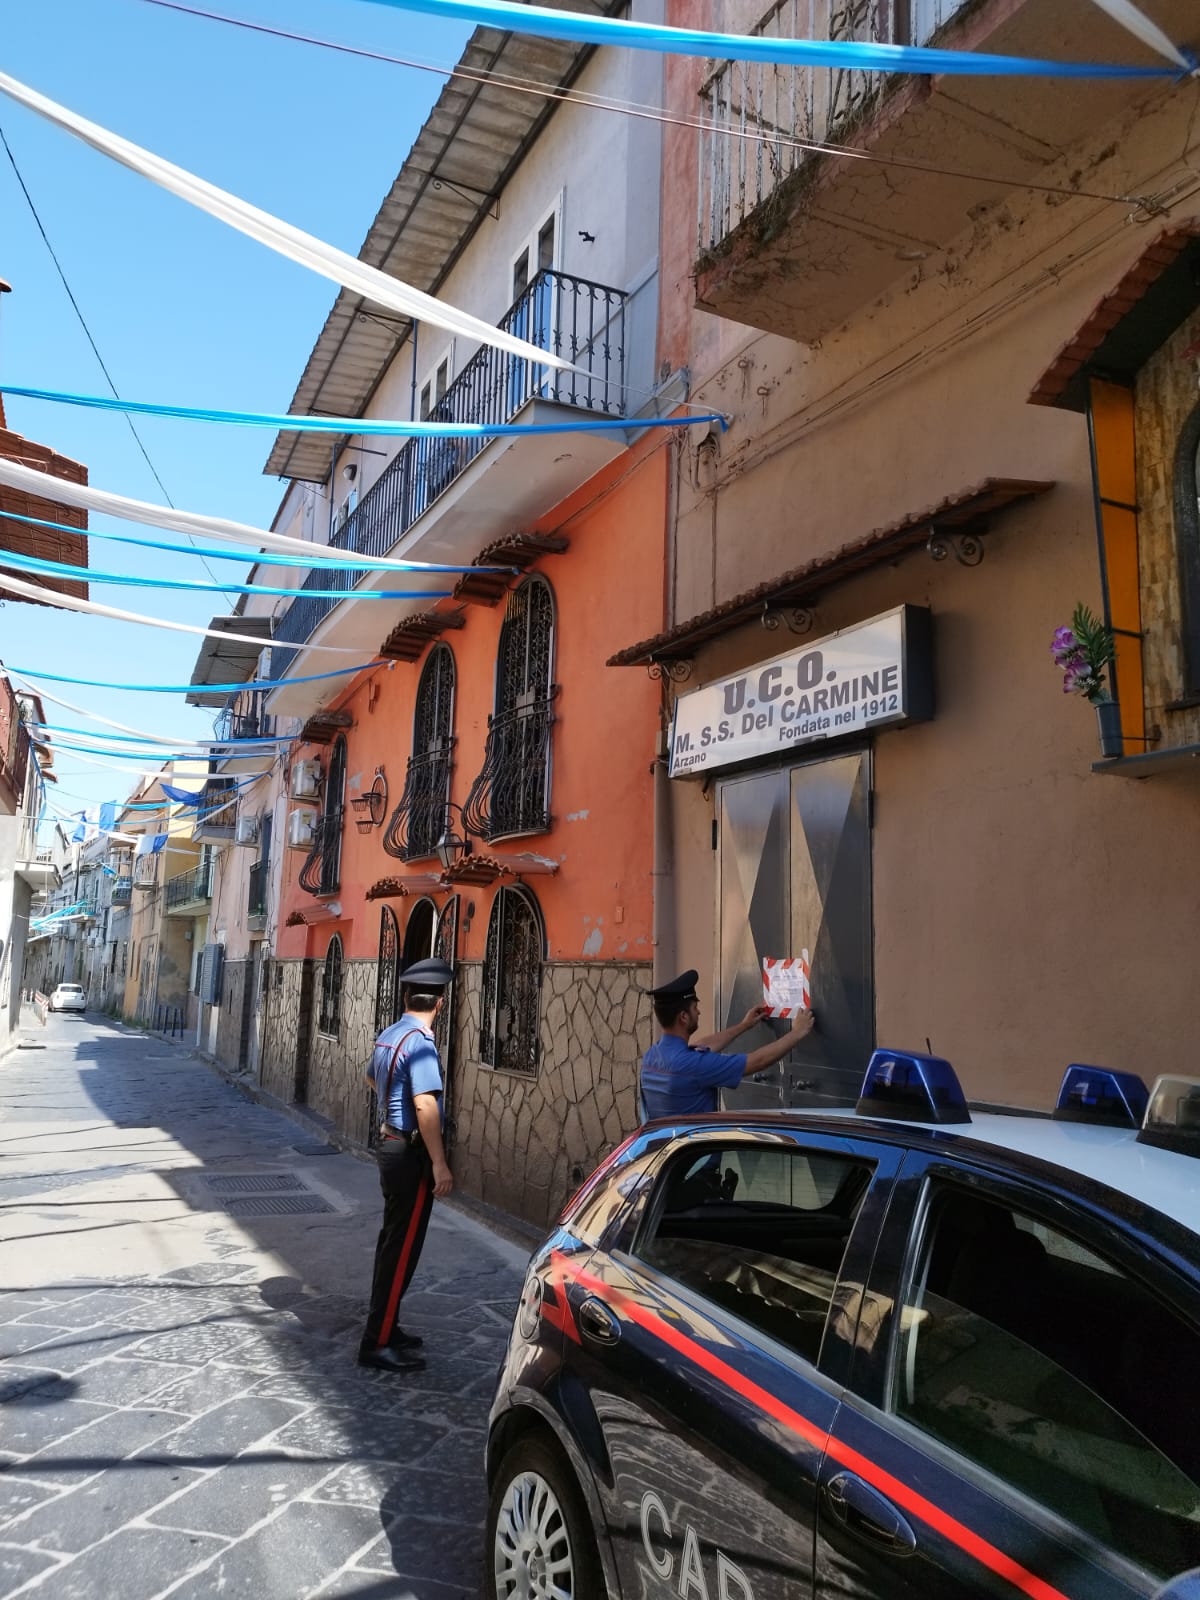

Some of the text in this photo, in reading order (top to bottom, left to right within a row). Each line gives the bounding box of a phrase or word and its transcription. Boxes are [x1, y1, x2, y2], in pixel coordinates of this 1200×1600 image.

[675, 665, 898, 755] M. S.S. Del CARMINE
[723, 650, 837, 716] U.C.O.
[779, 694, 898, 742] Fondata nel 1912
[673, 752, 707, 770] Arzano
